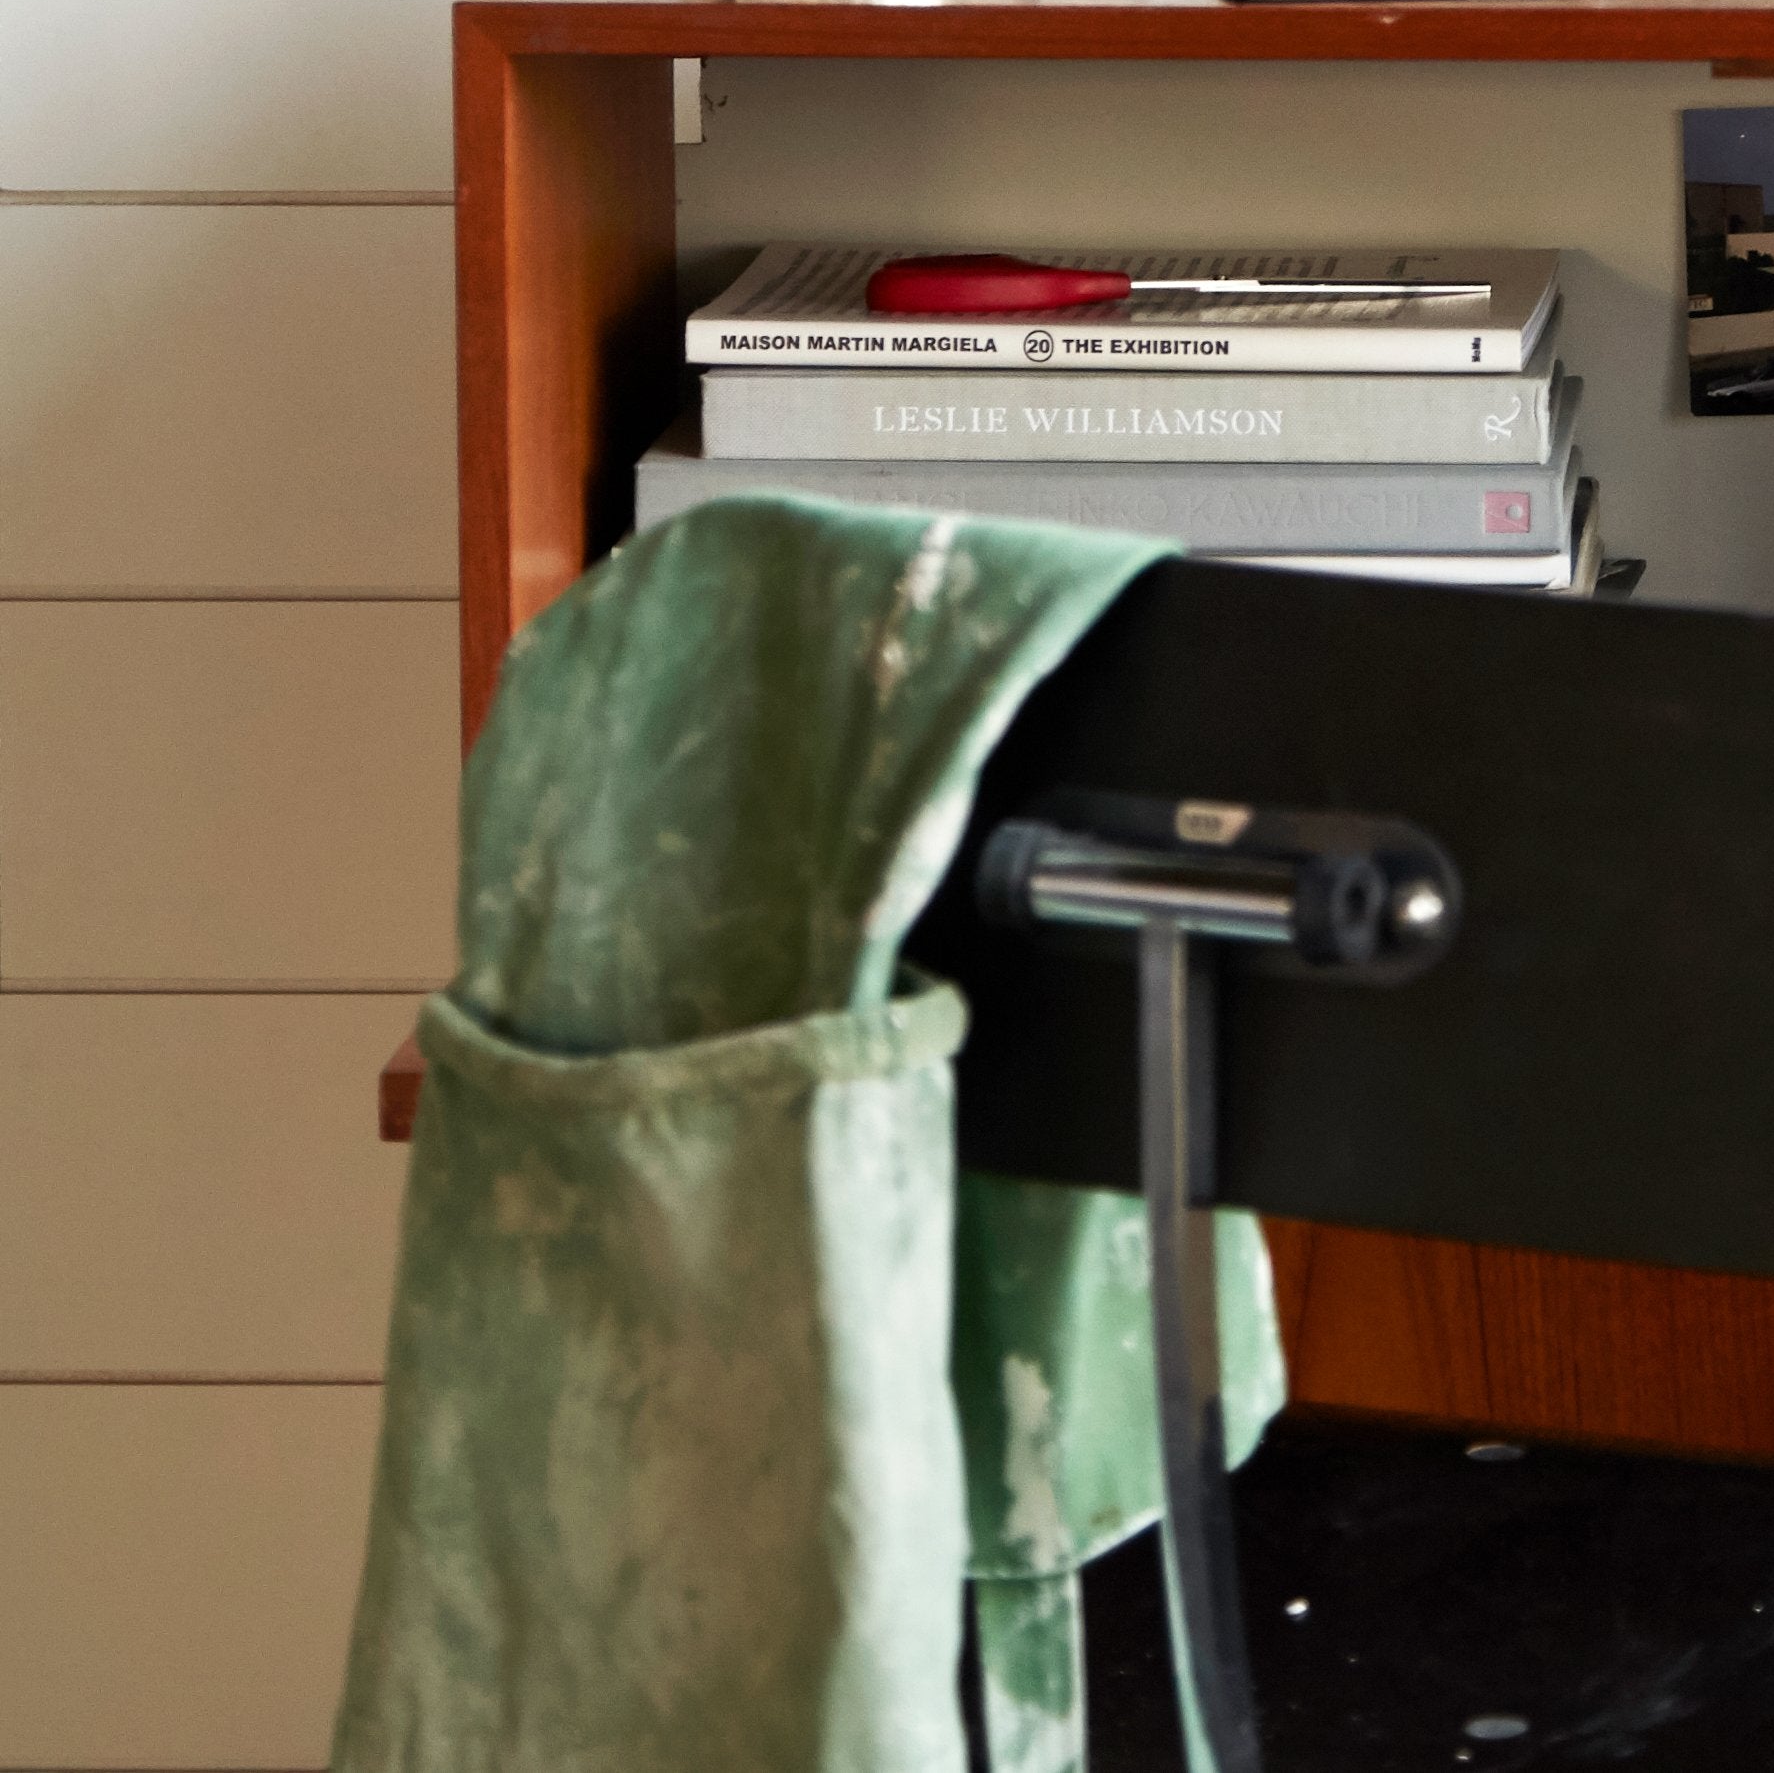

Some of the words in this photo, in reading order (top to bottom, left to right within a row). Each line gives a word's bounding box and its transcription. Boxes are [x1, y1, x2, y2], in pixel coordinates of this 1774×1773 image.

[720, 334, 801, 351] MAISON
[807, 336, 885, 352] MARTIN
[892, 337, 998, 353] MARGIELA
[1026, 339, 1051, 354] 20
[1062, 339, 1104, 354] THE
[1110, 339, 1230, 355] EXHIBITION
[872, 406, 1008, 434] LESLIE
[1022, 407, 1284, 436] WILLIAMSON
